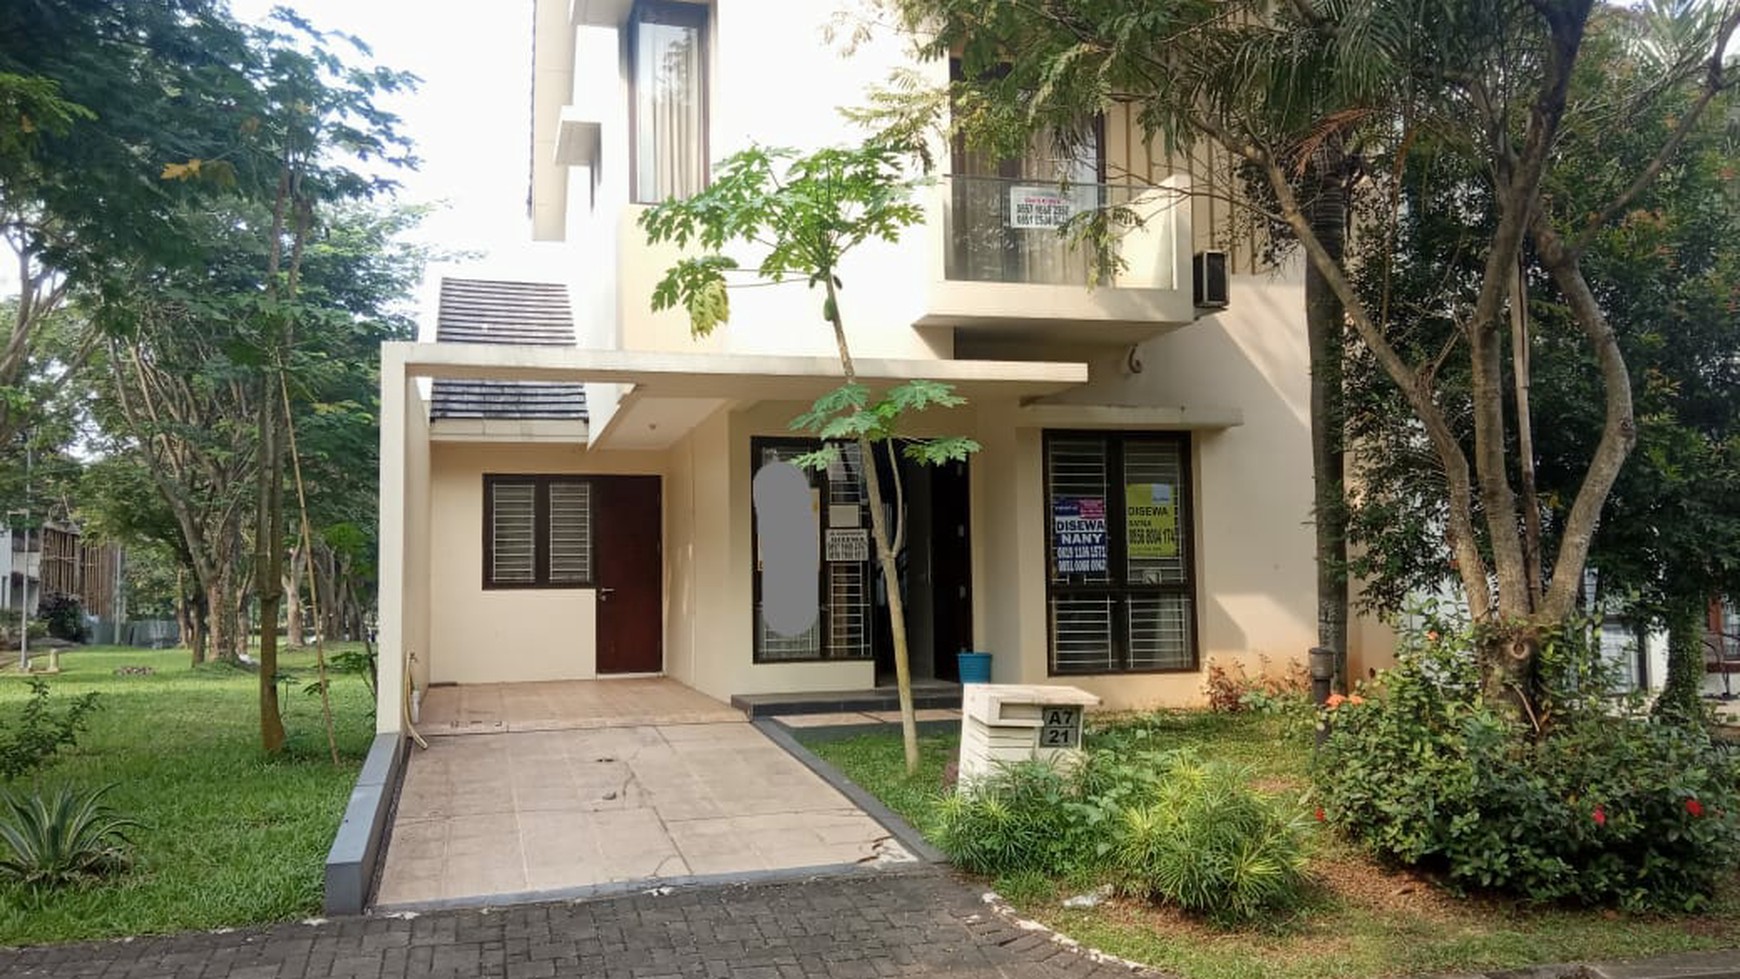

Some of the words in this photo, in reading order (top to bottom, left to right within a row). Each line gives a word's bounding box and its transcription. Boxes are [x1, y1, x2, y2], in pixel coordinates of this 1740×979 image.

[1128, 506, 1169, 517] DISEWA
[1057, 519, 1104, 531] DISEWA
[1061, 533, 1102, 545] NANY
[1049, 711, 1073, 725] A7
[1049, 729, 1069, 743] 21
